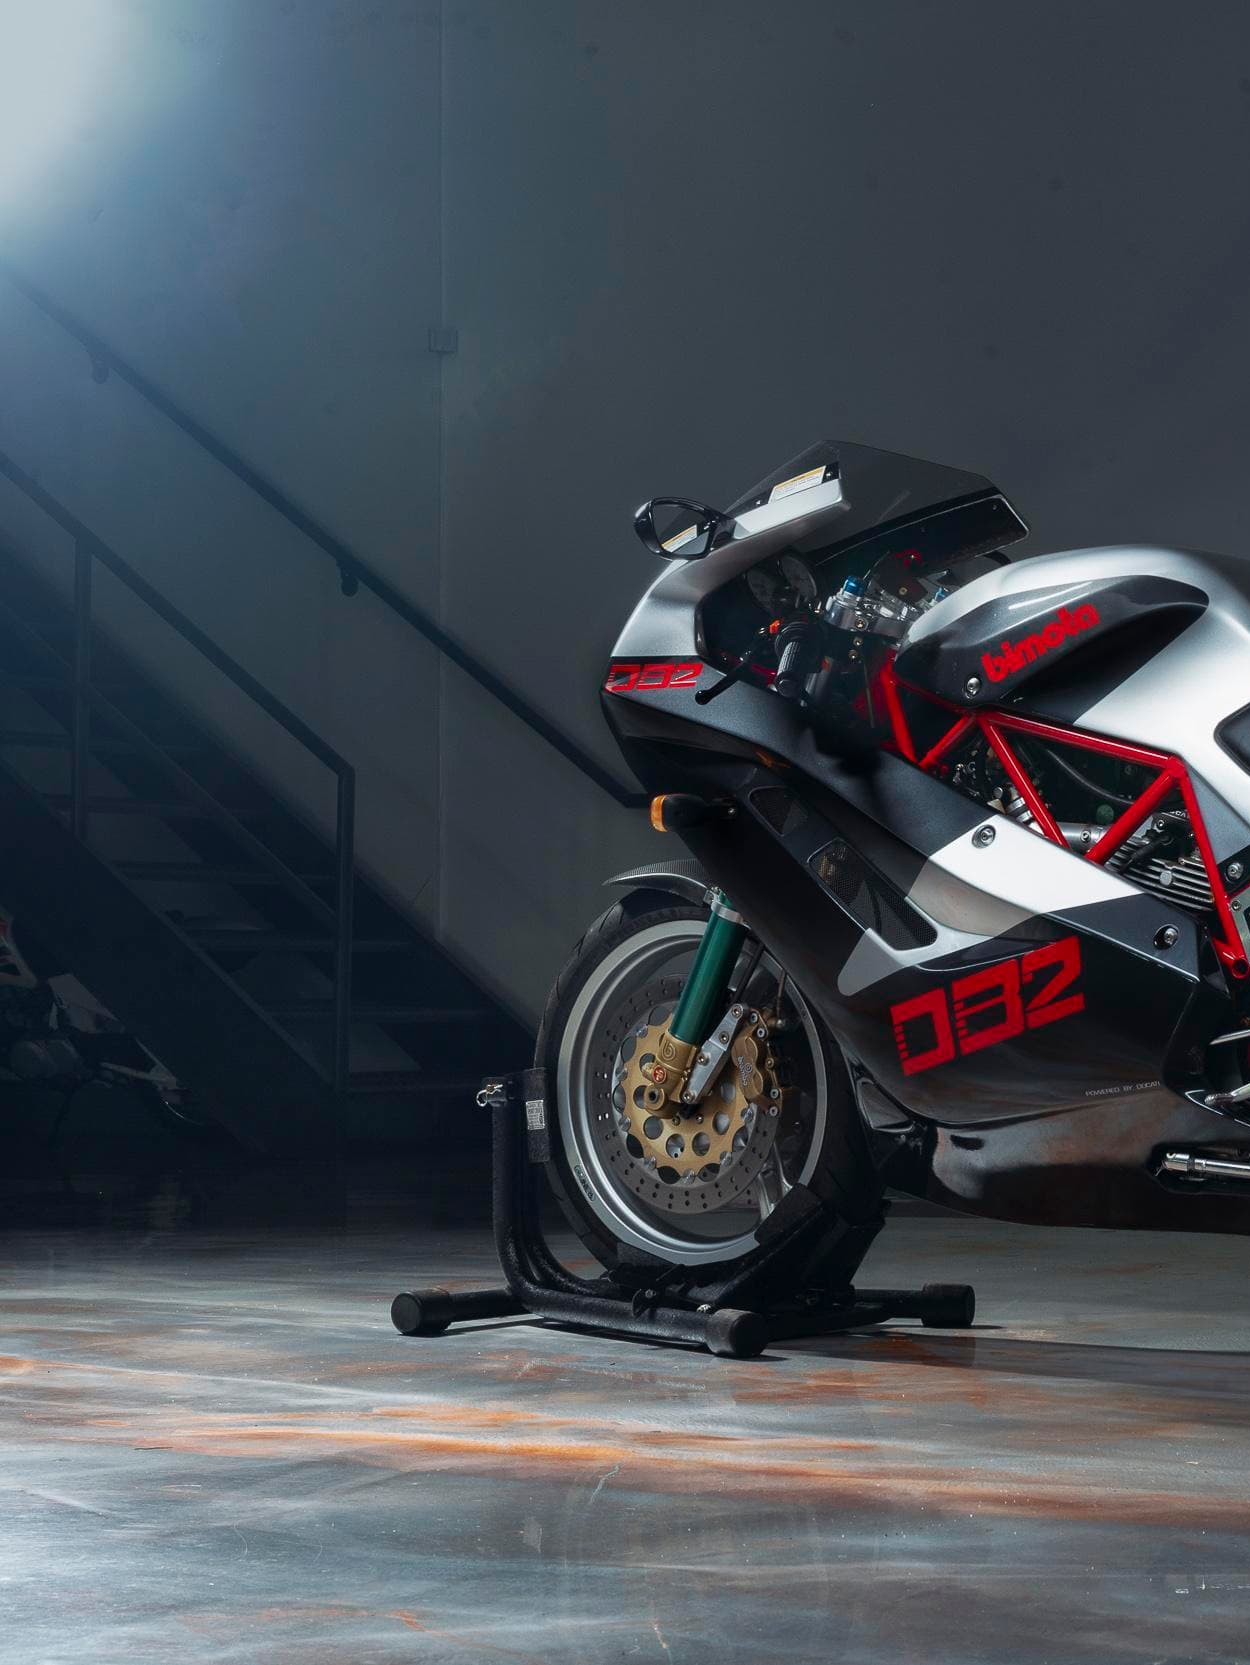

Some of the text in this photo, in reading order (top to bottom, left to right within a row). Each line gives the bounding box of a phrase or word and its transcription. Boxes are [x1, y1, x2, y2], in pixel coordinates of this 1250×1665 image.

[981, 604, 1099, 683] bimota
[1085, 1080, 1161, 1097] POWERED BY DUCATI
